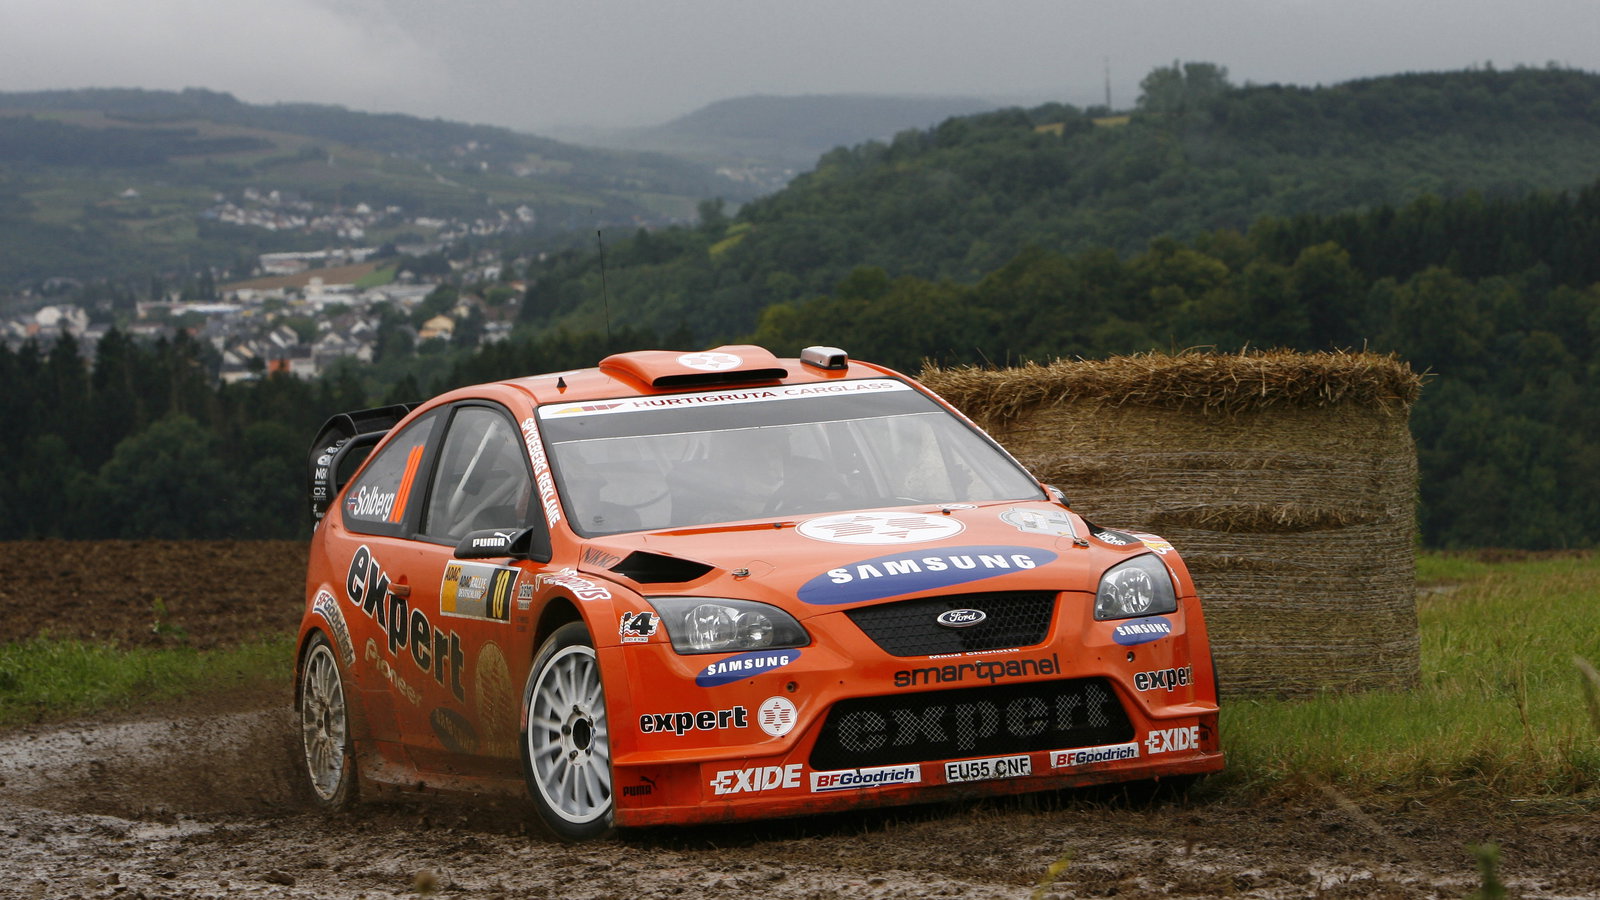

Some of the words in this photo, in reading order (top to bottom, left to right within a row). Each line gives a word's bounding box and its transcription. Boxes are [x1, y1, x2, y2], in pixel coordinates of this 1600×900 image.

[633, 391, 775, 408] HURTIGRUTA
[784, 382, 894, 396] CARGLASS
[521, 418, 548, 476] SPYDEBERG
[537, 472, 561, 529] REKLAME
[353, 485, 395, 521] Solberg
[472, 537, 505, 547] PUMA
[584, 546, 621, 569] NIKKO
[827, 552, 1036, 584] SAMSUNG
[492, 569, 511, 619] 10
[346, 544, 465, 704] expert
[949, 611, 977, 622] Ford
[1116, 622, 1171, 636] SAMSUNG
[707, 655, 789, 676] SAMSUNG
[928, 652, 962, 660] Maud
[965, 648, 1020, 656] Charlotte
[893, 653, 1061, 687] smartpanel
[640, 706, 747, 735] expert
[838, 684, 1109, 751] expert
[1145, 726, 1199, 753] EXIDE
[947, 764, 991, 782] EU55
[995, 757, 1029, 775] CNF
[1056, 745, 1135, 768] BFGoodrich
[623, 785, 651, 796] PUMA
[711, 764, 802, 795] EXIDE
[816, 767, 914, 788] BFGoodrich
